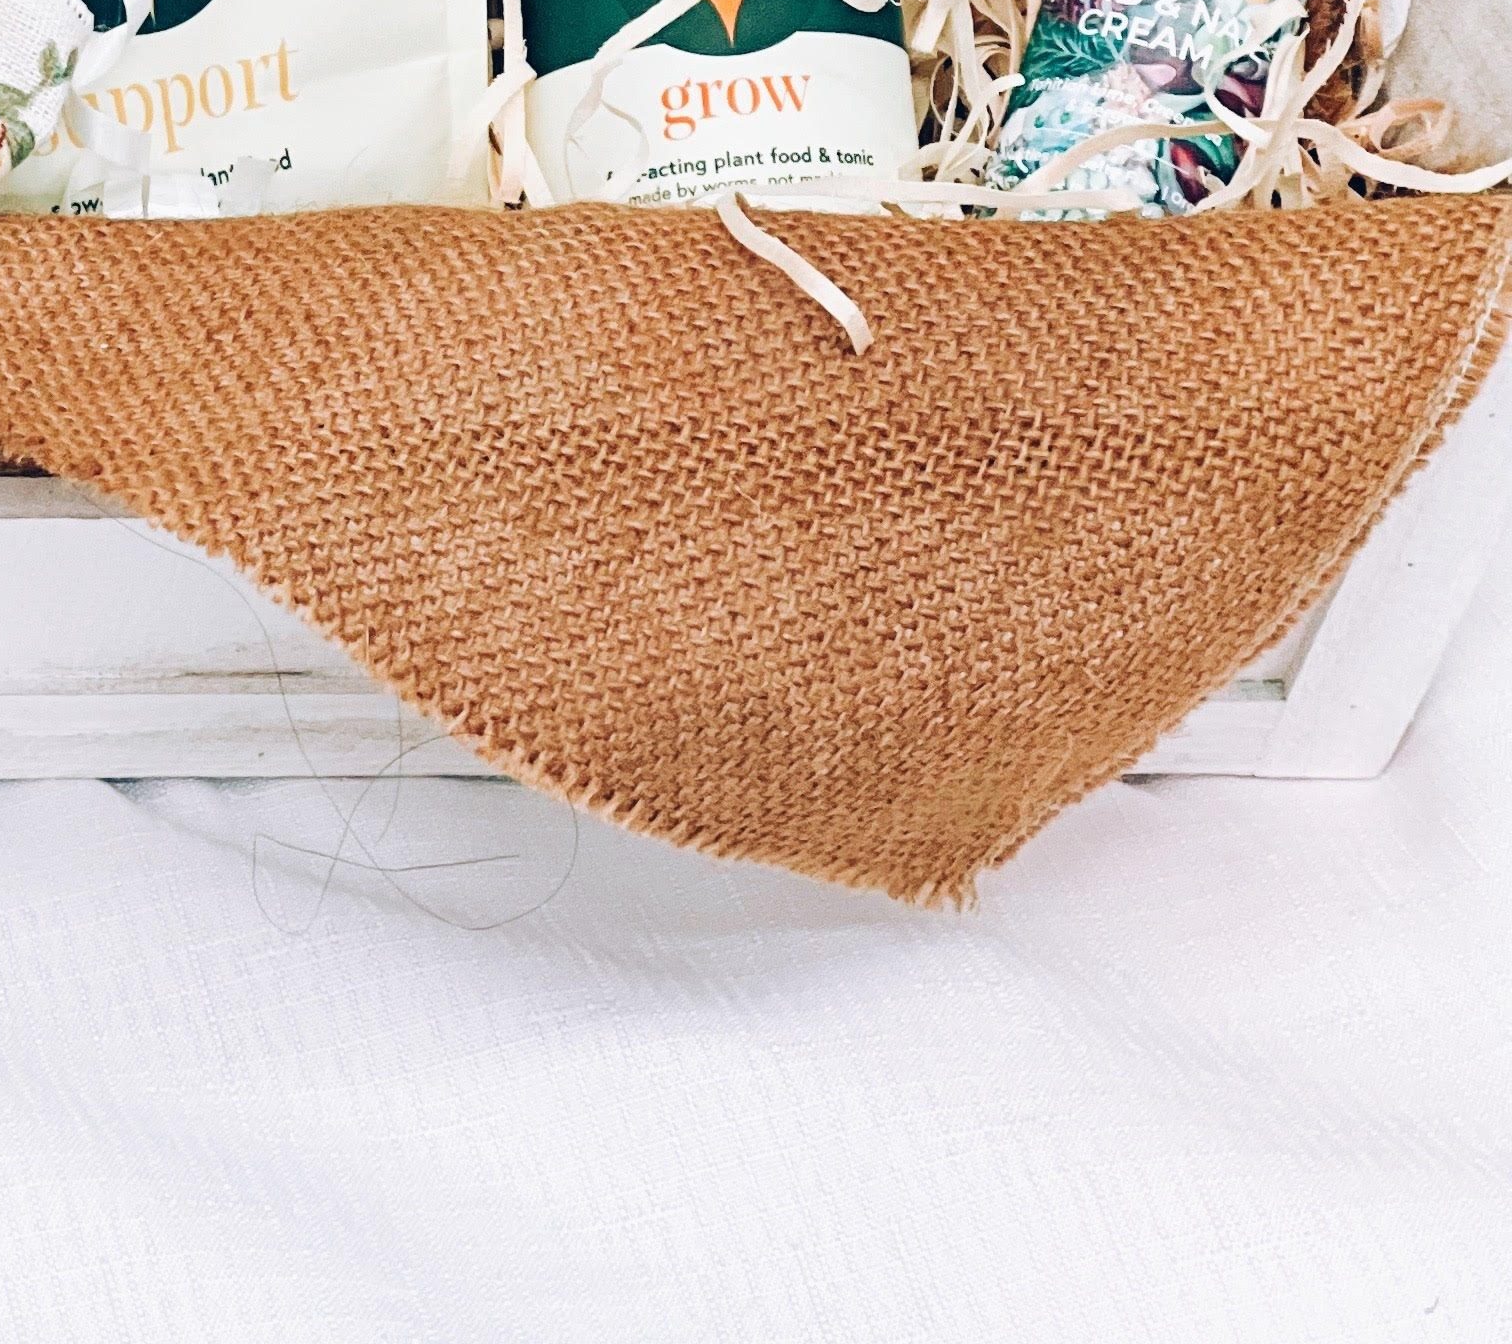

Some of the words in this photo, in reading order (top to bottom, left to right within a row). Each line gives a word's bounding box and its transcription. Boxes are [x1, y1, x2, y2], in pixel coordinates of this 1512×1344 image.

[1077, 8, 1215, 71] CREAM
[660, 74, 811, 142] grow
[714, 151, 764, 174] plant
[771, 146, 812, 165] food
[819, 147, 831, 163] &
[837, 148, 874, 166] tonic
[628, 185, 671, 206] made
[677, 179, 697, 198] by
